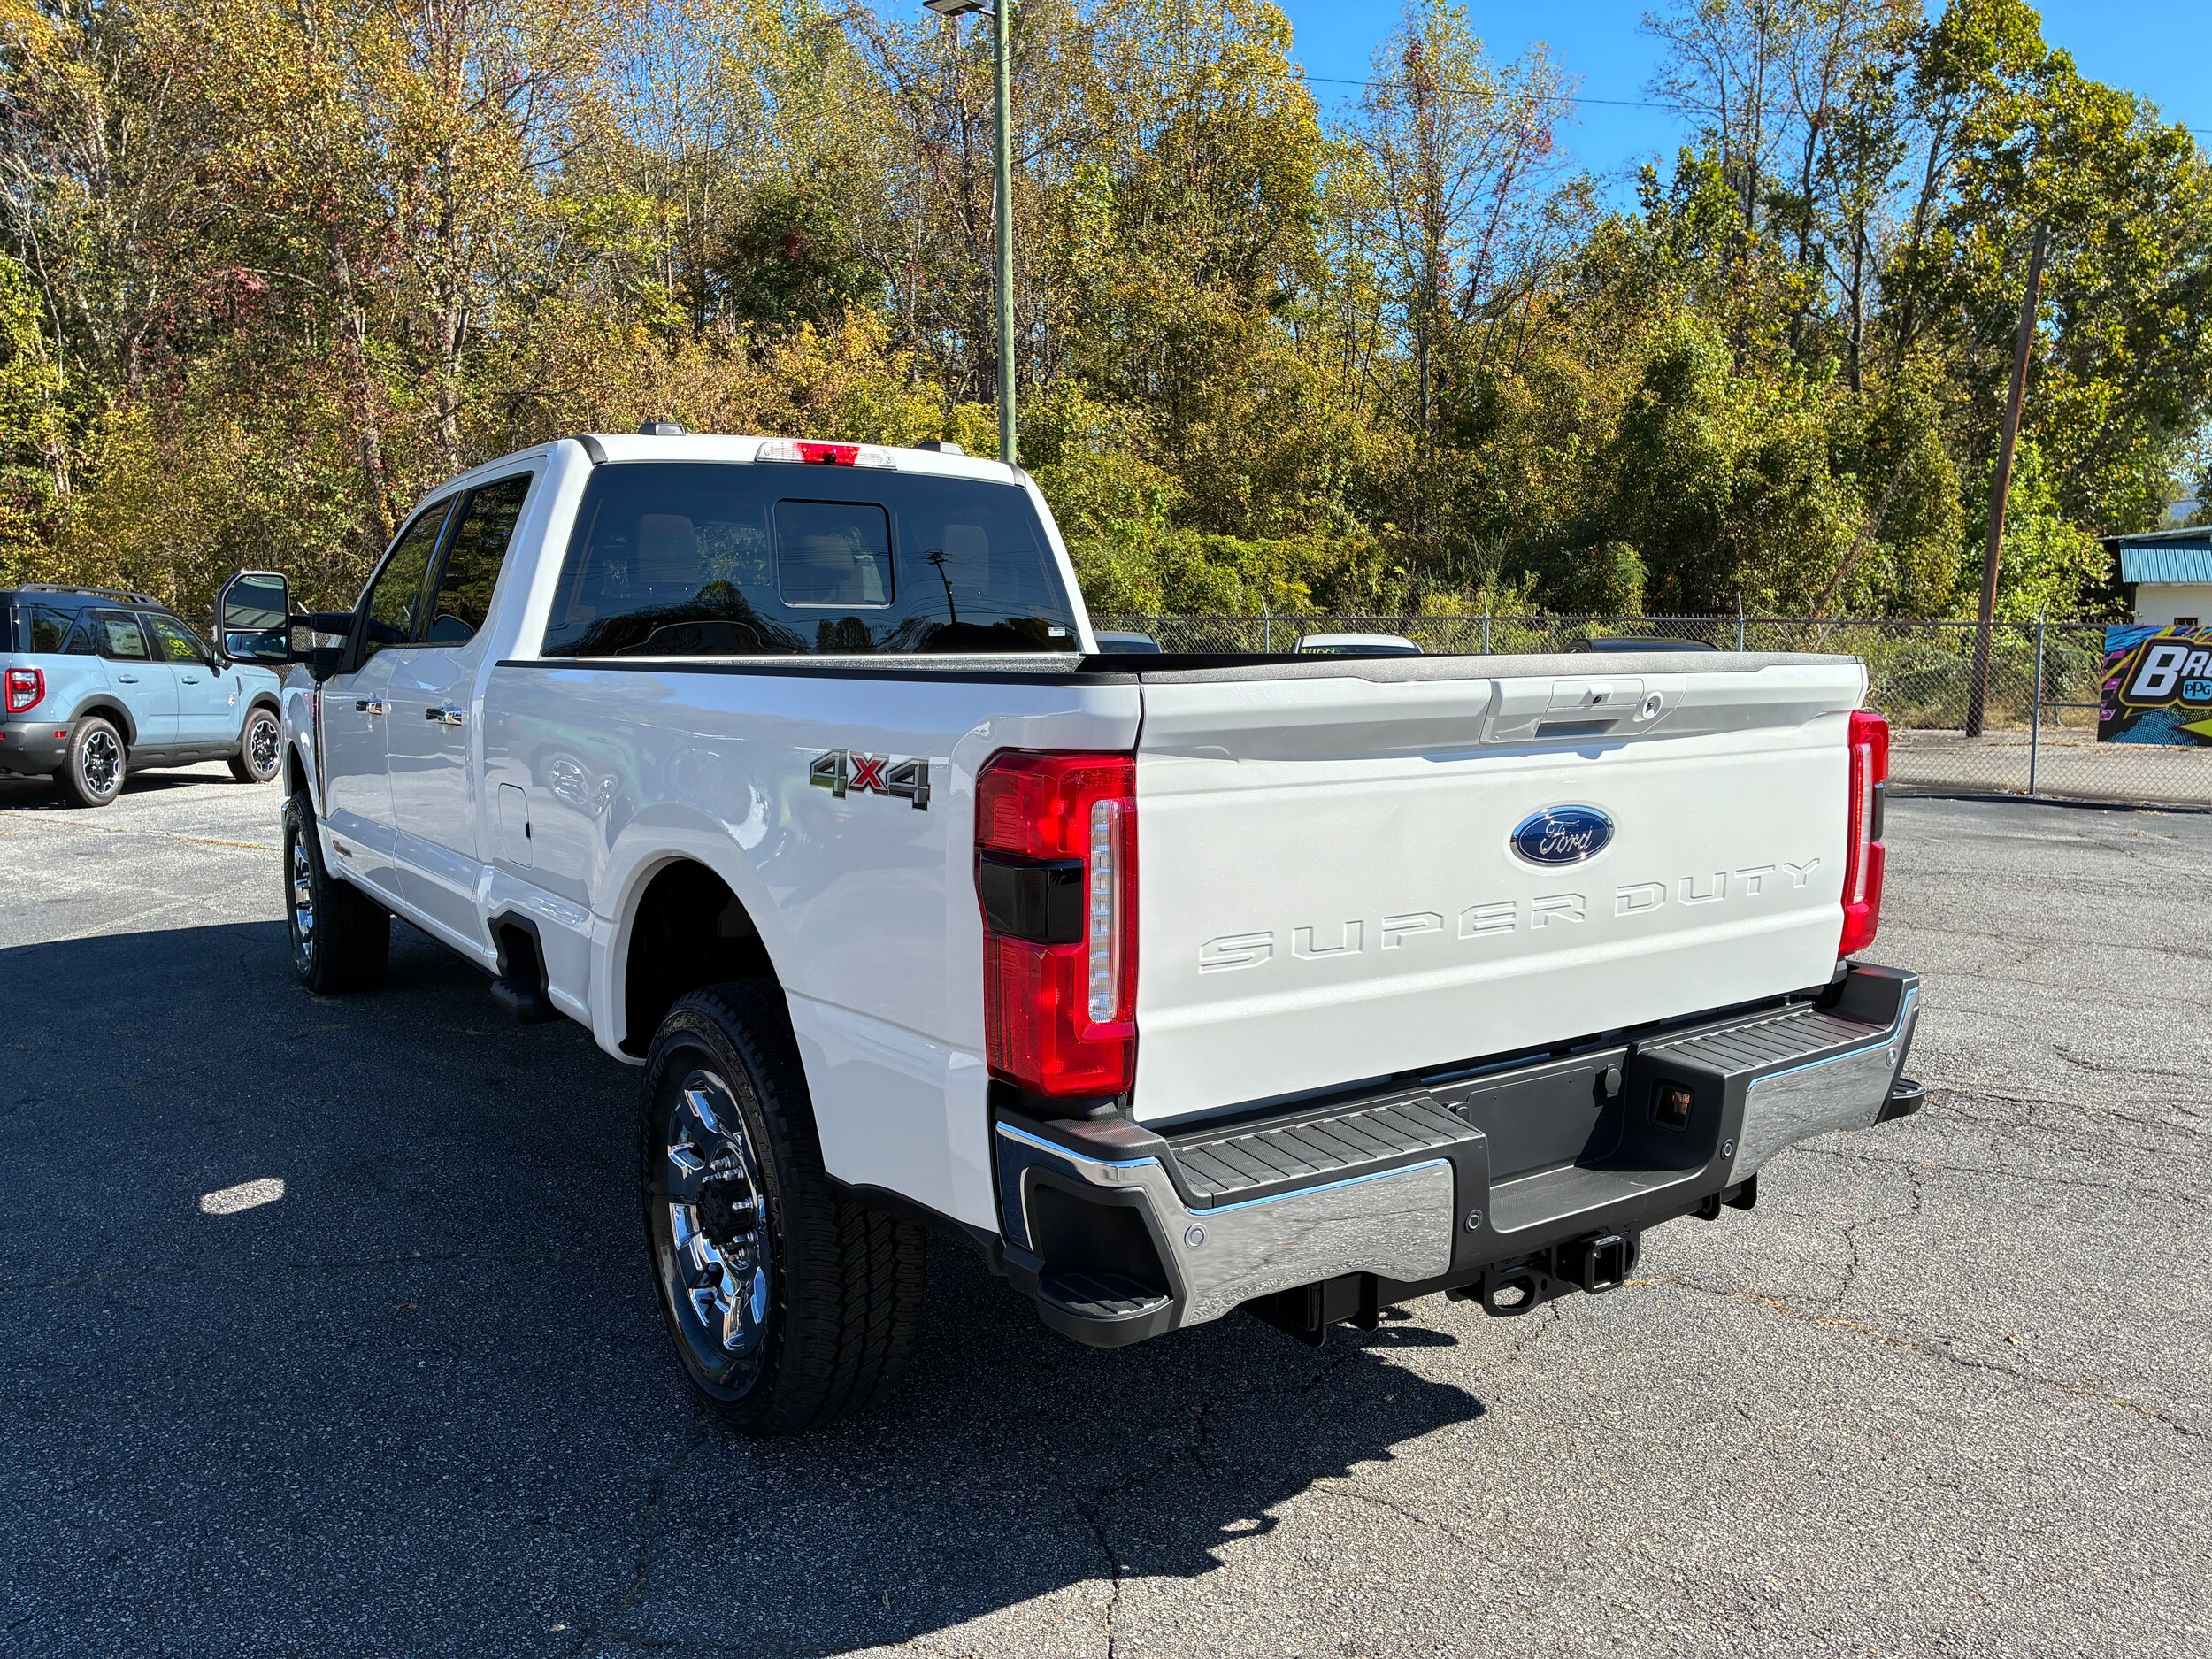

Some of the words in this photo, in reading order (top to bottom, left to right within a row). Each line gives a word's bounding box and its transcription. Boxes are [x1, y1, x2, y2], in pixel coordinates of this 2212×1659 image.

[2185, 681, 2211, 697] PPG
[1539, 819, 1593, 855] Ford
[1199, 893, 1586, 974] SUPER
[1614, 857, 1821, 917] DUTY
